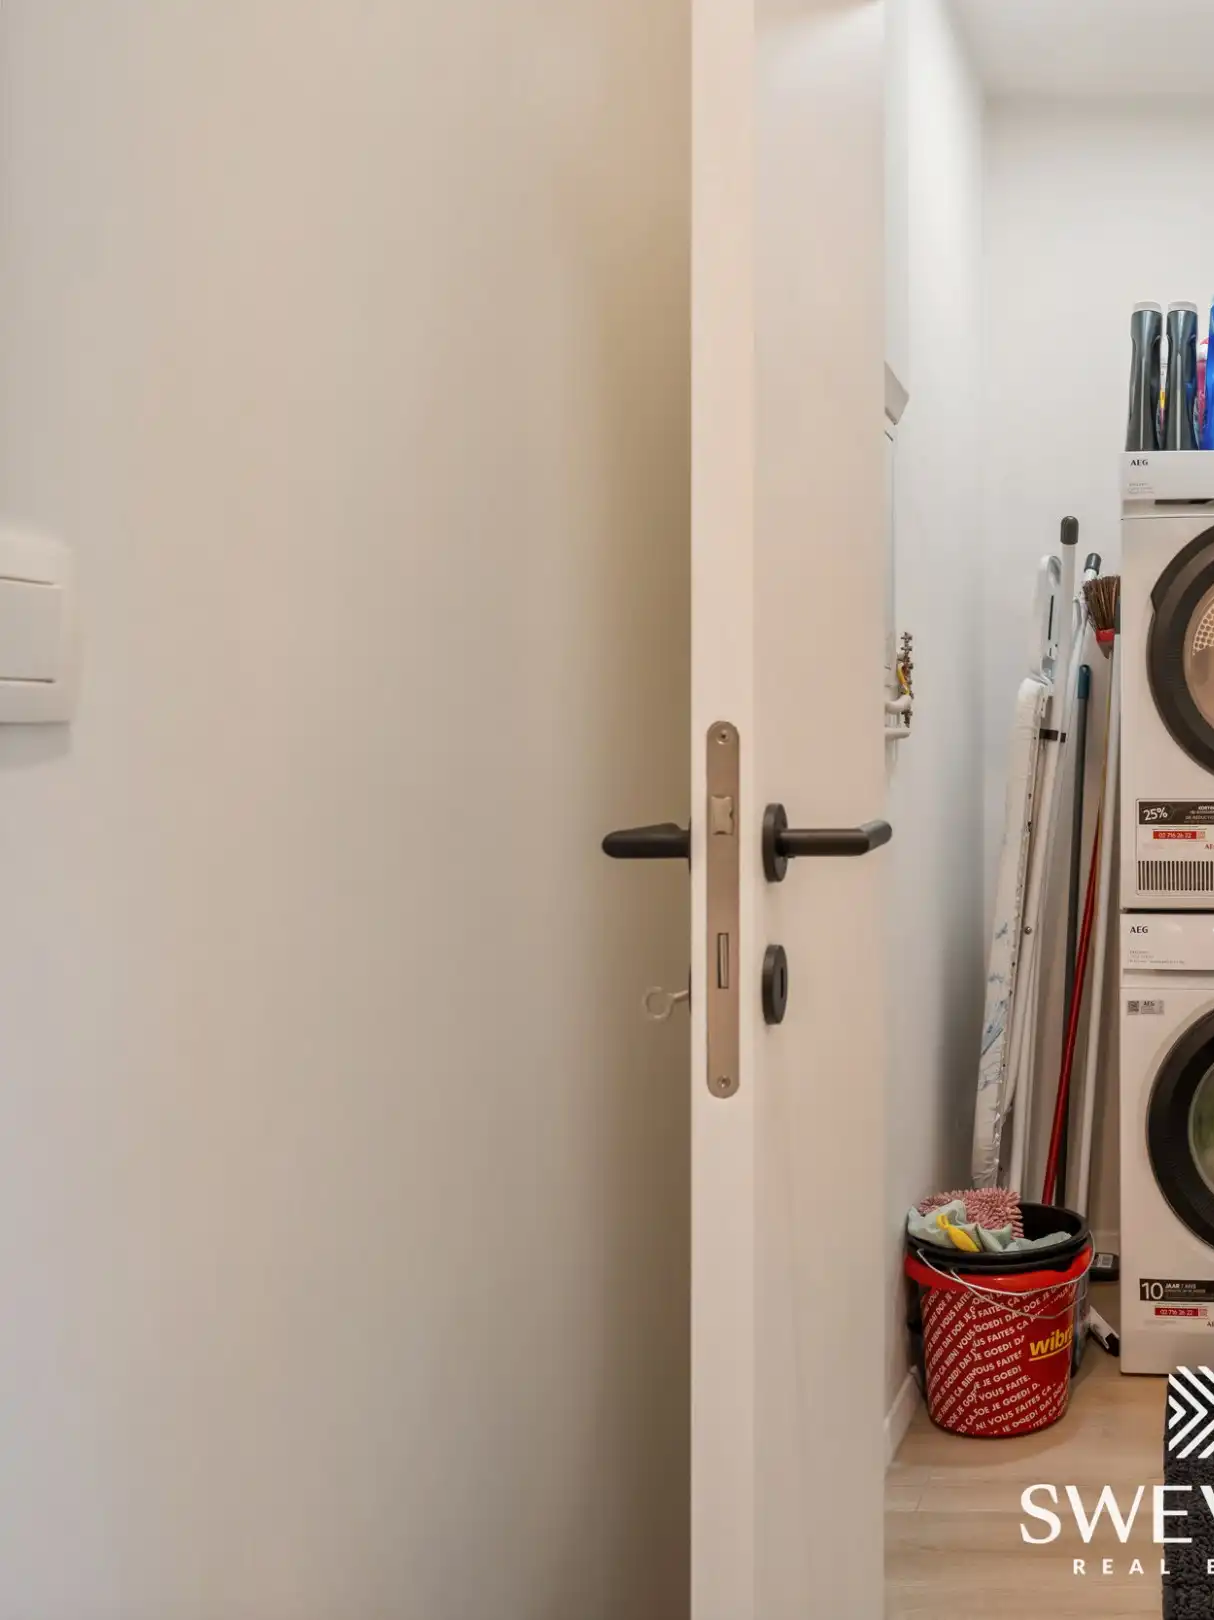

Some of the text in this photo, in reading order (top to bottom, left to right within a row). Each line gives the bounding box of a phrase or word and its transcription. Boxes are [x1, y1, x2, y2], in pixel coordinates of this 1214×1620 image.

[1143, 806, 1168, 821] 25%
[1129, 926, 1149, 934] AEG
[1141, 1282, 1164, 1300] 10
[940, 1310, 956, 1329] VOUS
[974, 1317, 1003, 1333] GOED!
[1023, 1298, 1040, 1313] DOE
[978, 1302, 1005, 1319] FAITES
[942, 1333, 953, 1348] DAT
[951, 1320, 965, 1336] DOE
[957, 1329, 976, 1349] VOUS
[987, 1326, 1015, 1343] FAITES
[1016, 1319, 1029, 1333] ÇA
[983, 1341, 1013, 1358] GOED!
[944, 1367, 961, 1389] GOED!
[959, 1353, 972, 1369] DAT
[982, 1377, 992, 1387] JE
[993, 1364, 1022, 1383] GOED!
[978, 1386, 1005, 1401] VOUS
[1006, 1374, 1031, 1391] FAITE
[987, 1410, 1015, 1426] VOUS
[1015, 1393, 1041, 1414] FAITES
[991, 1402, 1001, 1412] JE
[1002, 1387, 1031, 1406] GOED!
